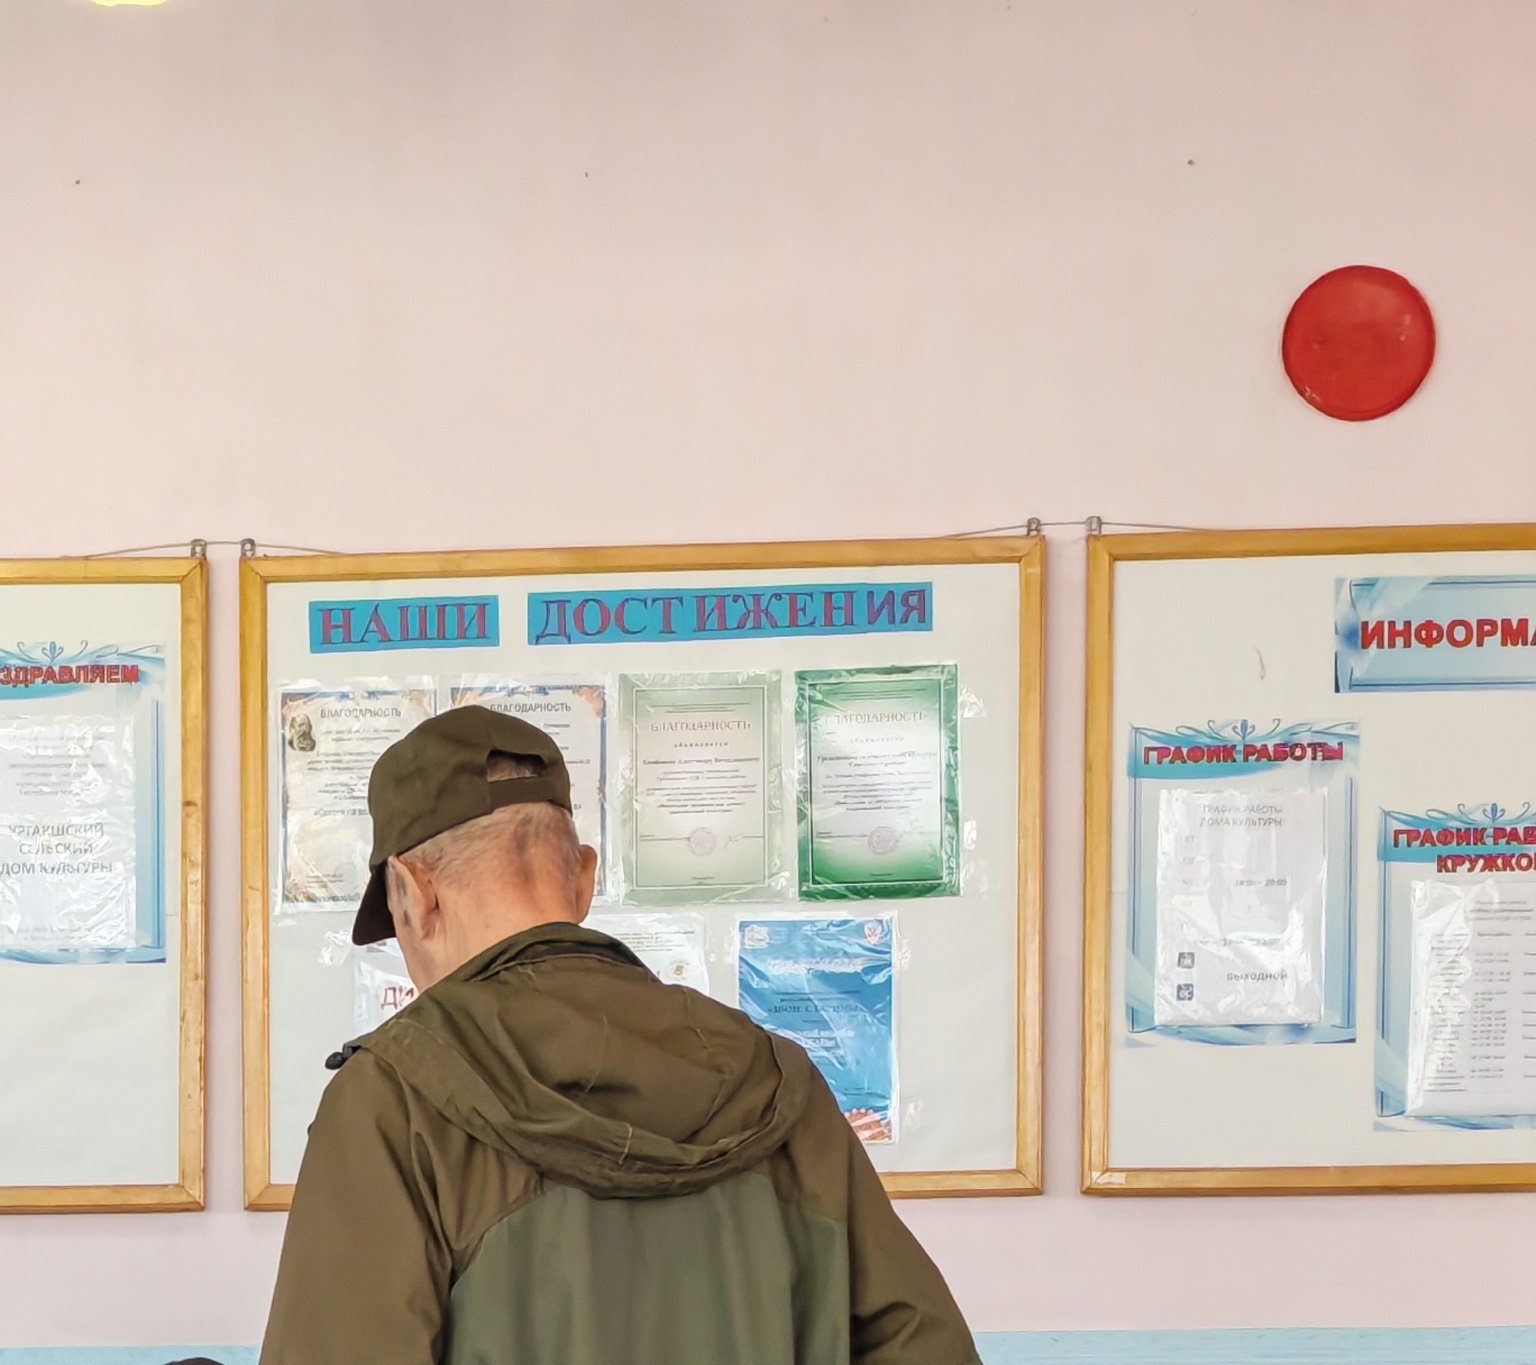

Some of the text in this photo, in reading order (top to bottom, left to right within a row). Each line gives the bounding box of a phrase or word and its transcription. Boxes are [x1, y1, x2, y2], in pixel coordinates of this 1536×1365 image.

[320, 588, 927, 646] НАШИ ДОСТИЖЕНИЯ
[1360, 618, 1536, 650] ИНФОРМ
[1143, 742, 1344, 766] ГРАФИК РАБОТЫ
[1393, 827, 1487, 848] ГРАФИК
[0, 862, 35, 878] ДОМ
[1436, 854, 1536, 873] КРУЖКО
